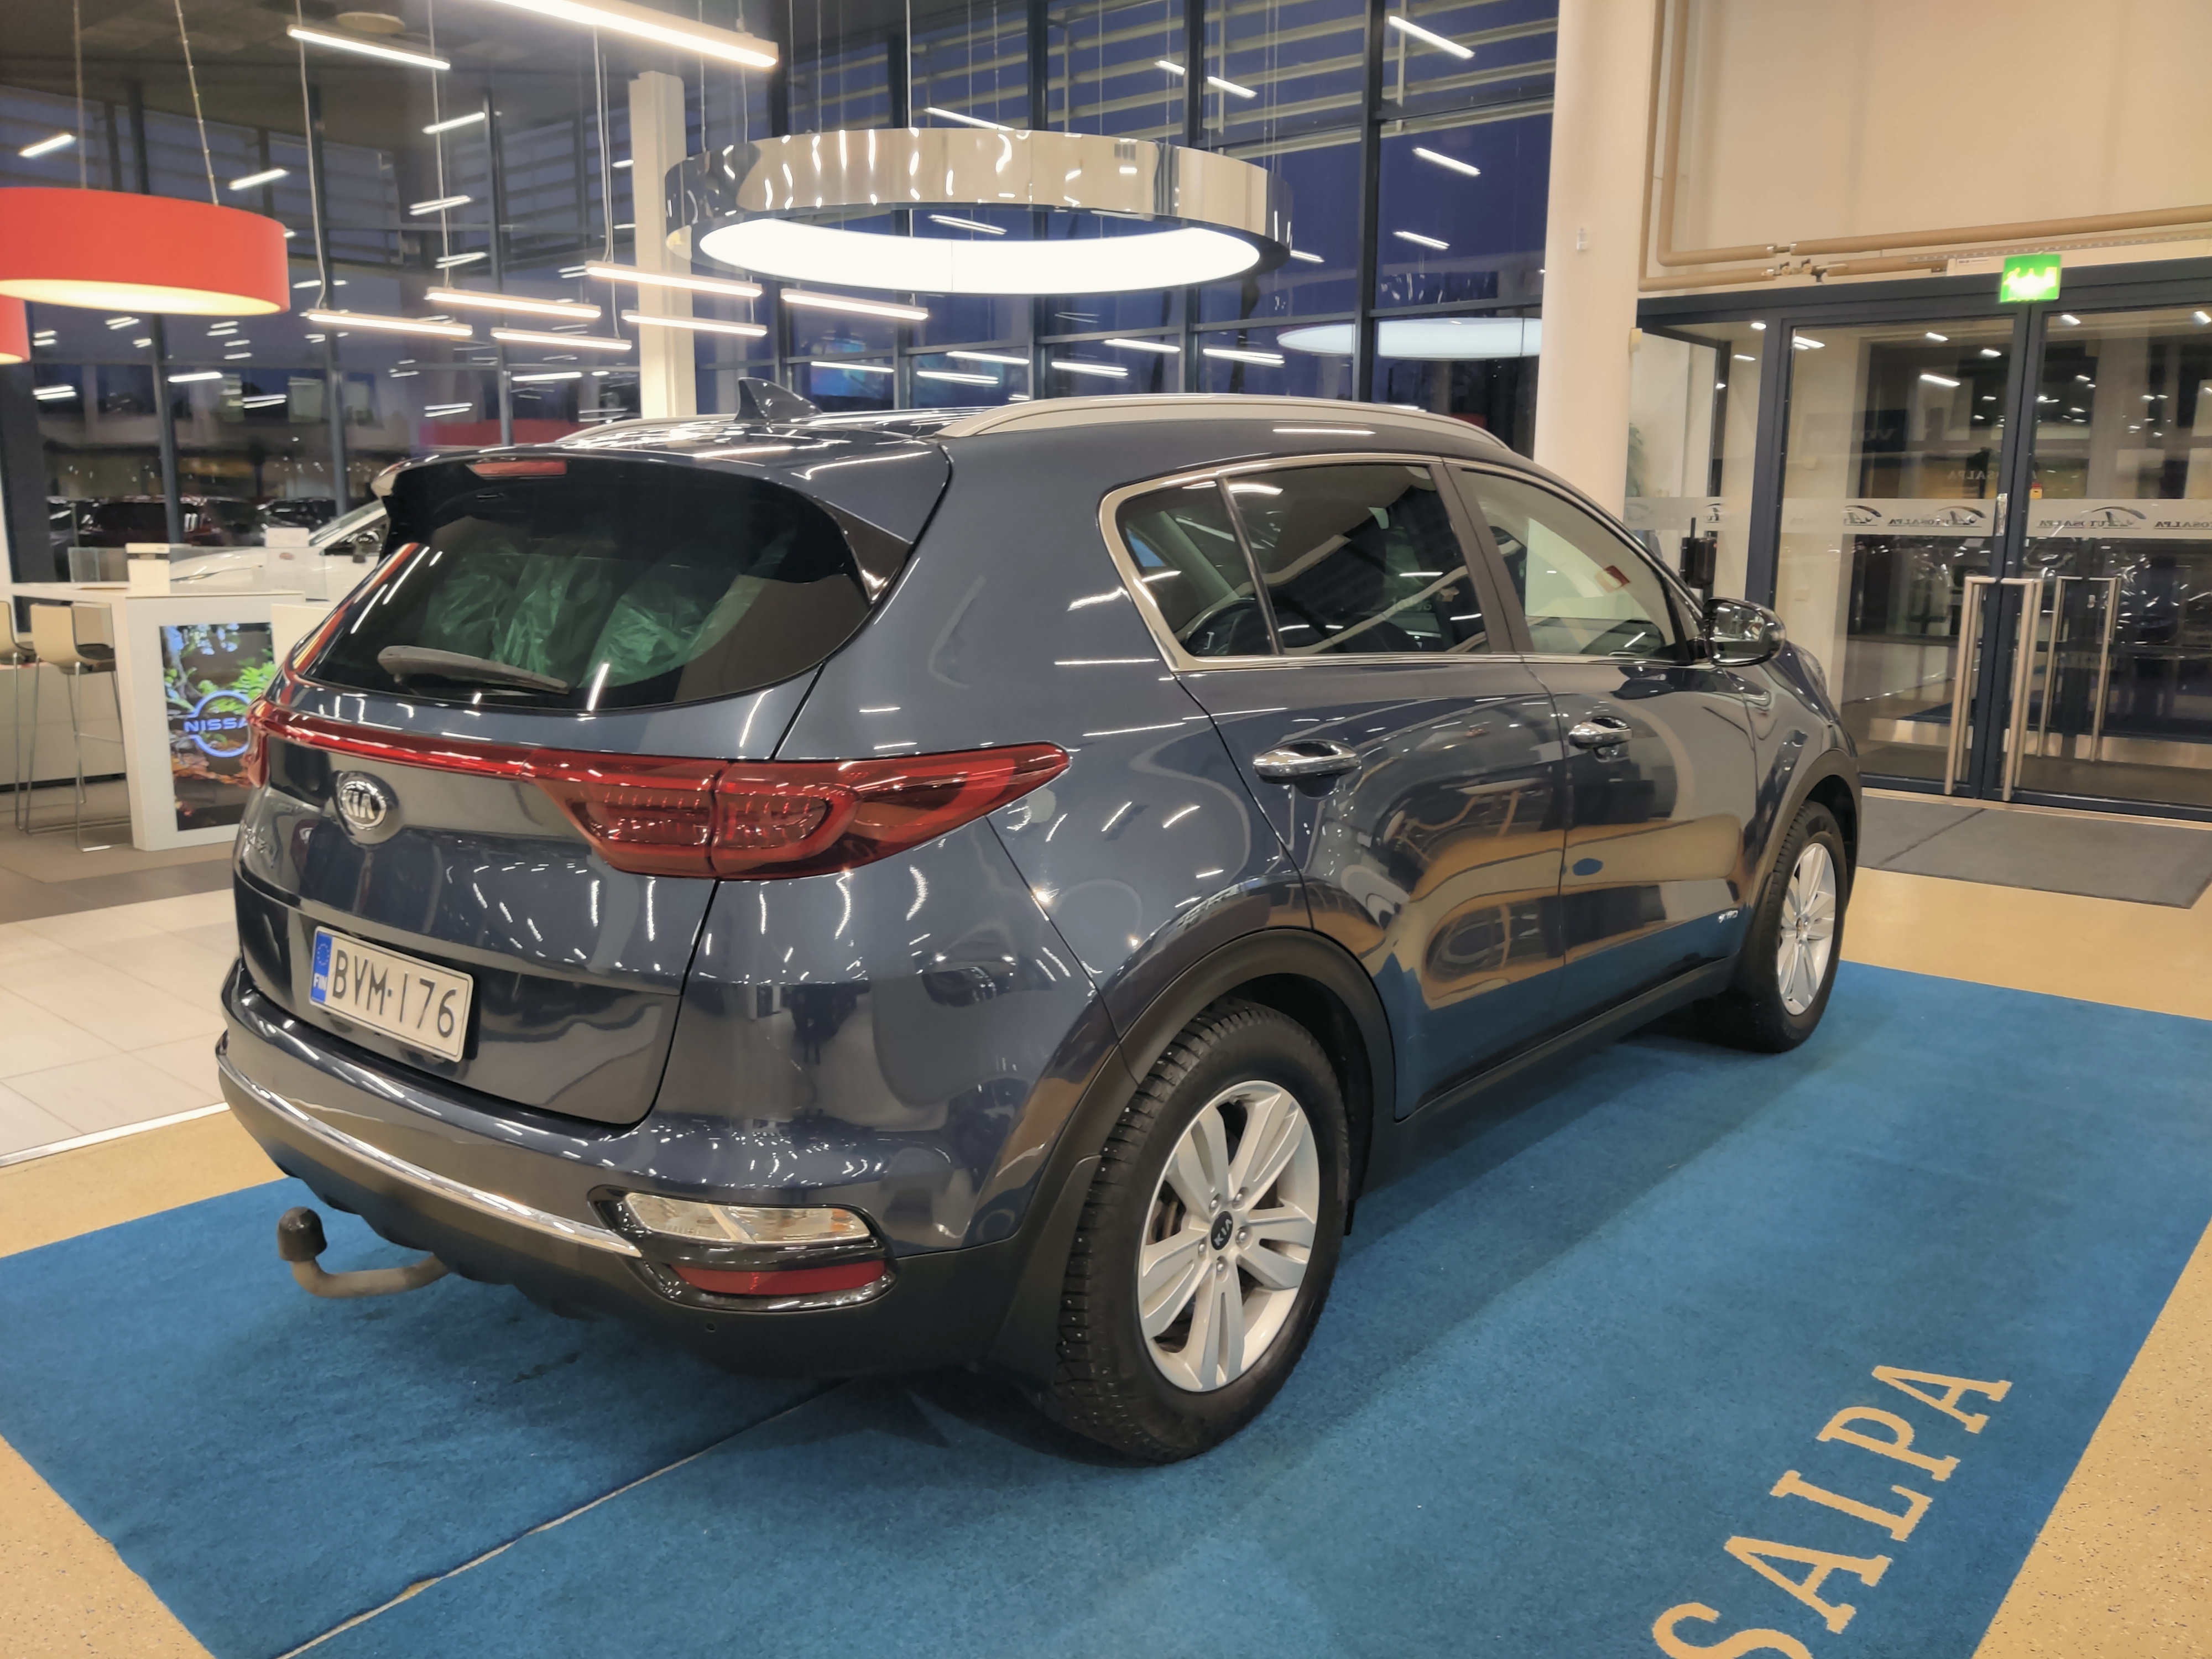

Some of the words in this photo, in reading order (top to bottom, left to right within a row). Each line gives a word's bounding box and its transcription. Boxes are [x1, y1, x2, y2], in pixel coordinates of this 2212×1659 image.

[184, 717, 248, 732] NISSA
[313, 973, 327, 991] FIN
[1213, 1219, 1233, 1246] KIA
